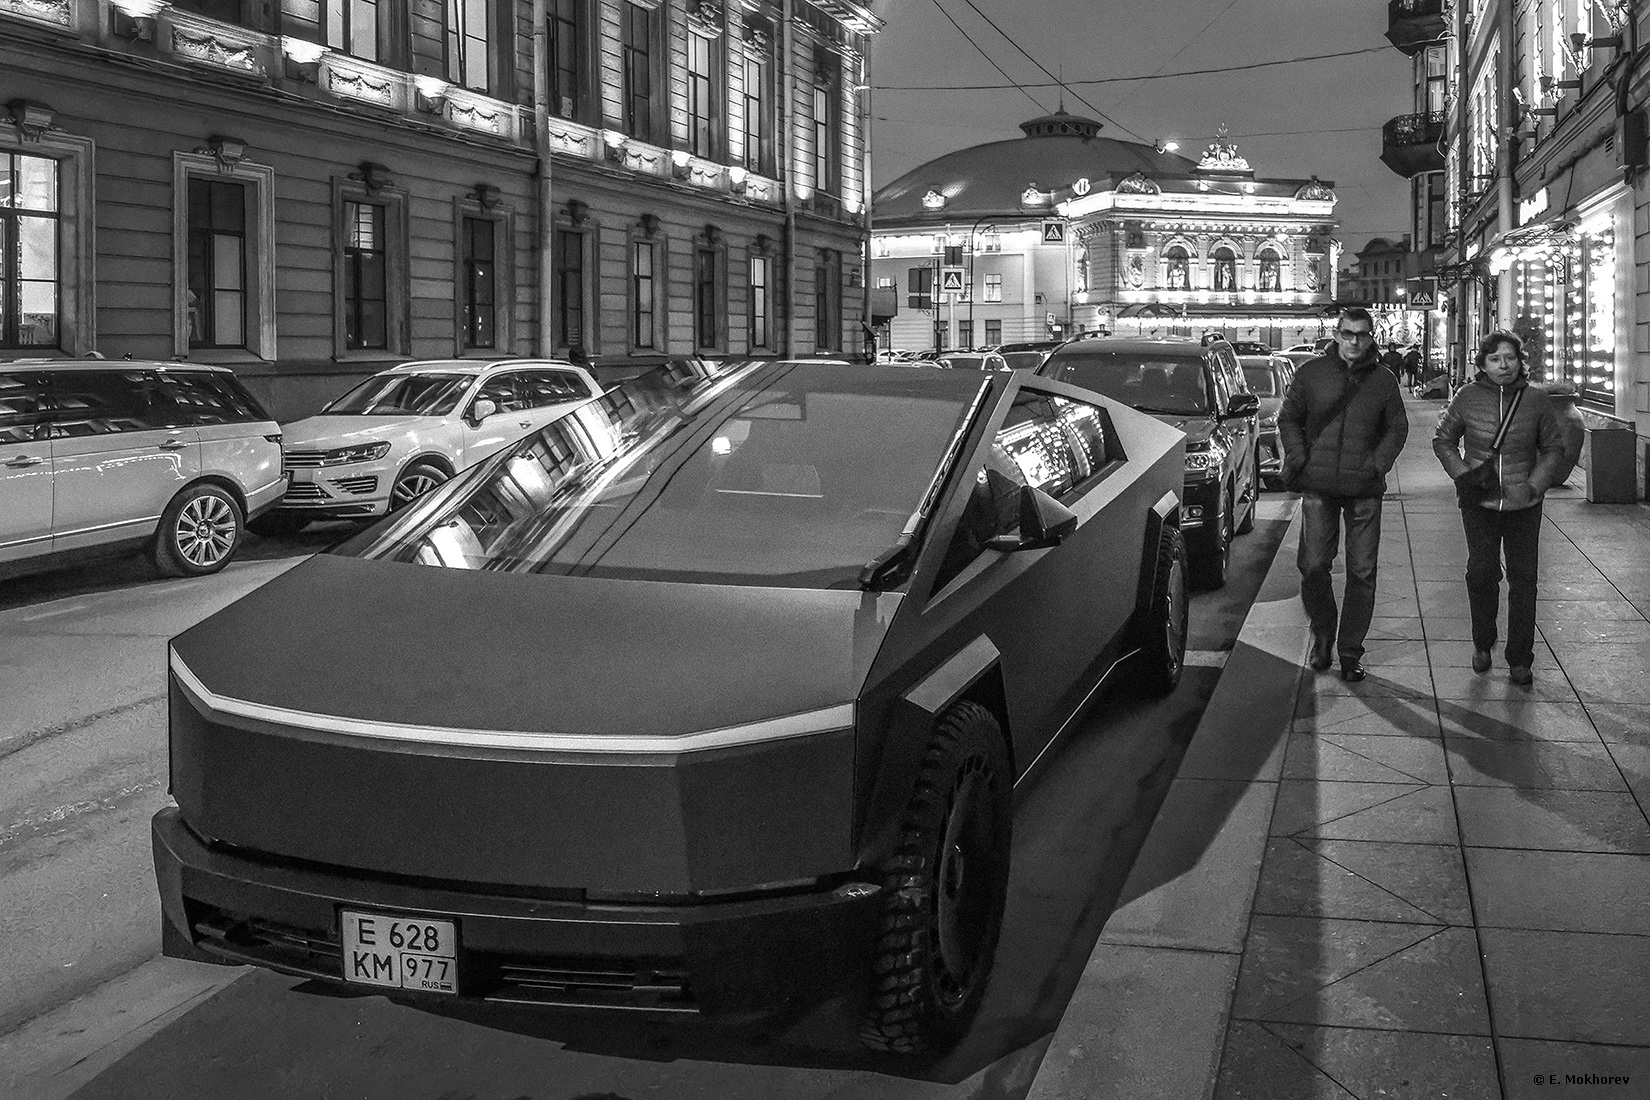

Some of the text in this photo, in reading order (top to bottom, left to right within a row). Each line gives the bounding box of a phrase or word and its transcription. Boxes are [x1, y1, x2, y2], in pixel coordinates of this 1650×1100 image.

[358, 918, 439, 952] E 628
[406, 957, 449, 980] 977
[421, 980, 439, 989] RUS
